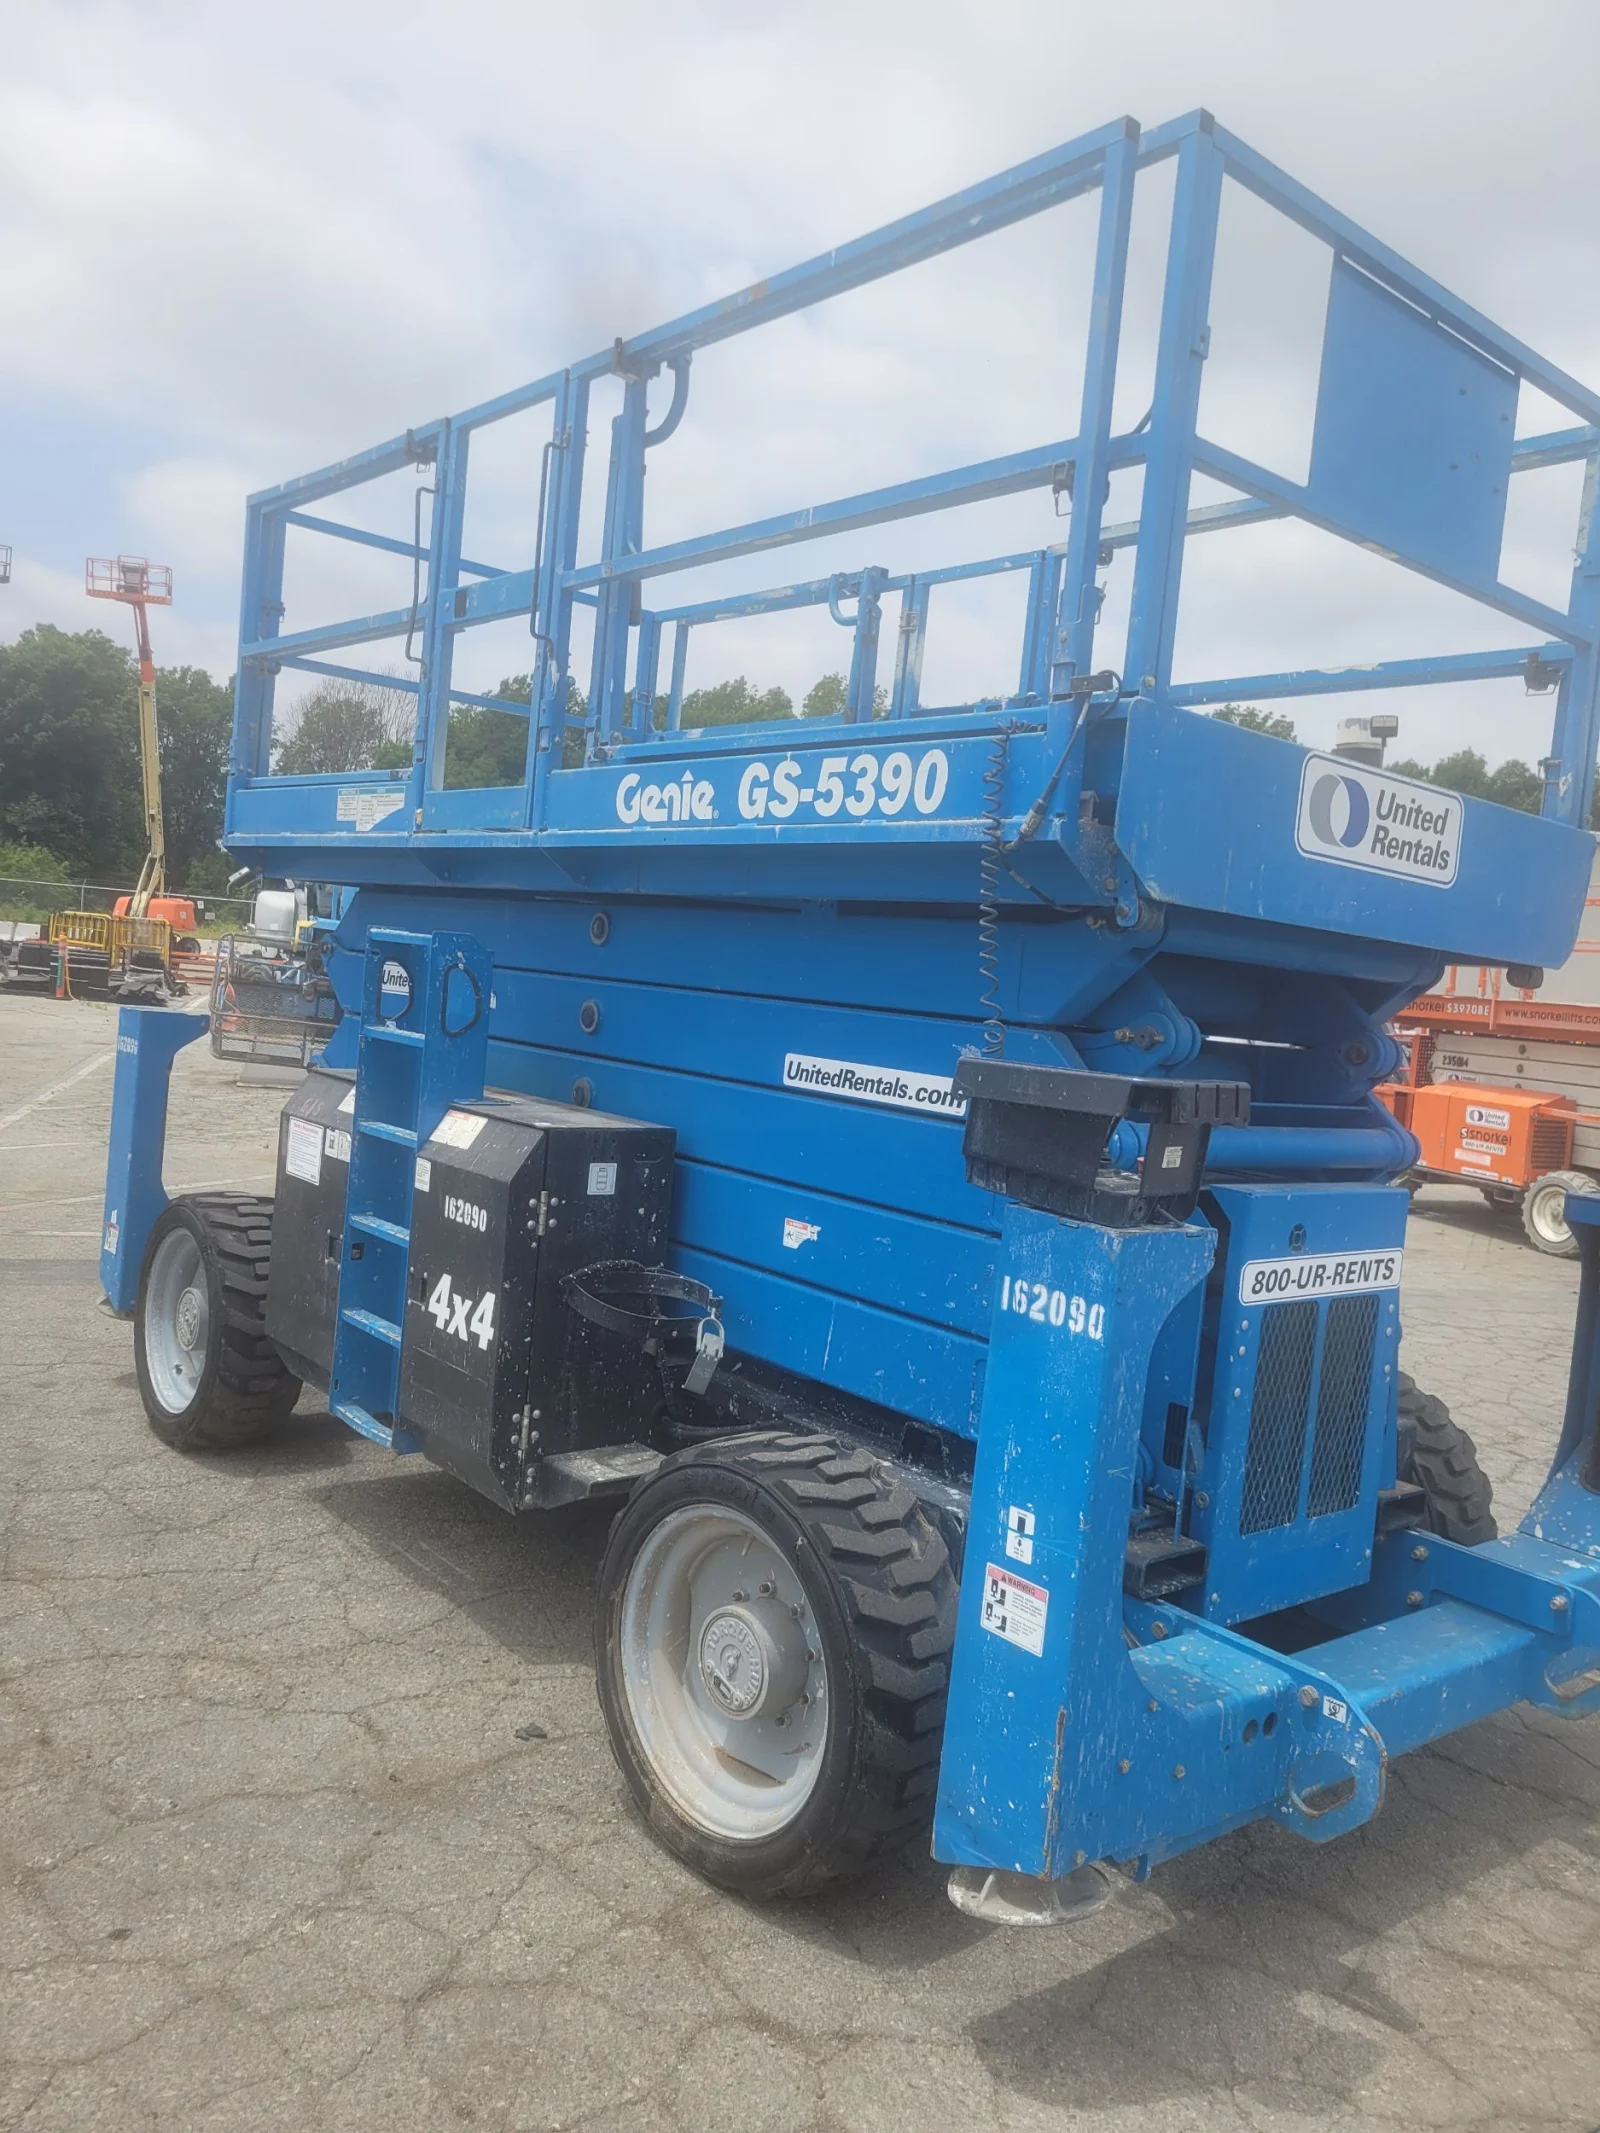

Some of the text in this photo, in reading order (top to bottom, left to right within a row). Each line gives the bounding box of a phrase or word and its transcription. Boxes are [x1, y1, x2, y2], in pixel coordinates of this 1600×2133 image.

[616, 748, 949, 824] Genie GS-5390
[1376, 789, 1450, 836] United
[1370, 824, 1451, 871] Rentals
[1504, 1009, 1600, 1025] www.snorkellifts.co
[1484, 1119, 1506, 1128] Rentals
[1485, 1111, 1506, 1121] United
[445, 1196, 487, 1232] 162090
[1251, 1257, 1395, 1295] 800-UR-RENTS
[428, 1273, 495, 1351] 4x4
[1001, 1275, 1105, 1340] 162090
[1007, 1575, 1036, 1596] WARNING
